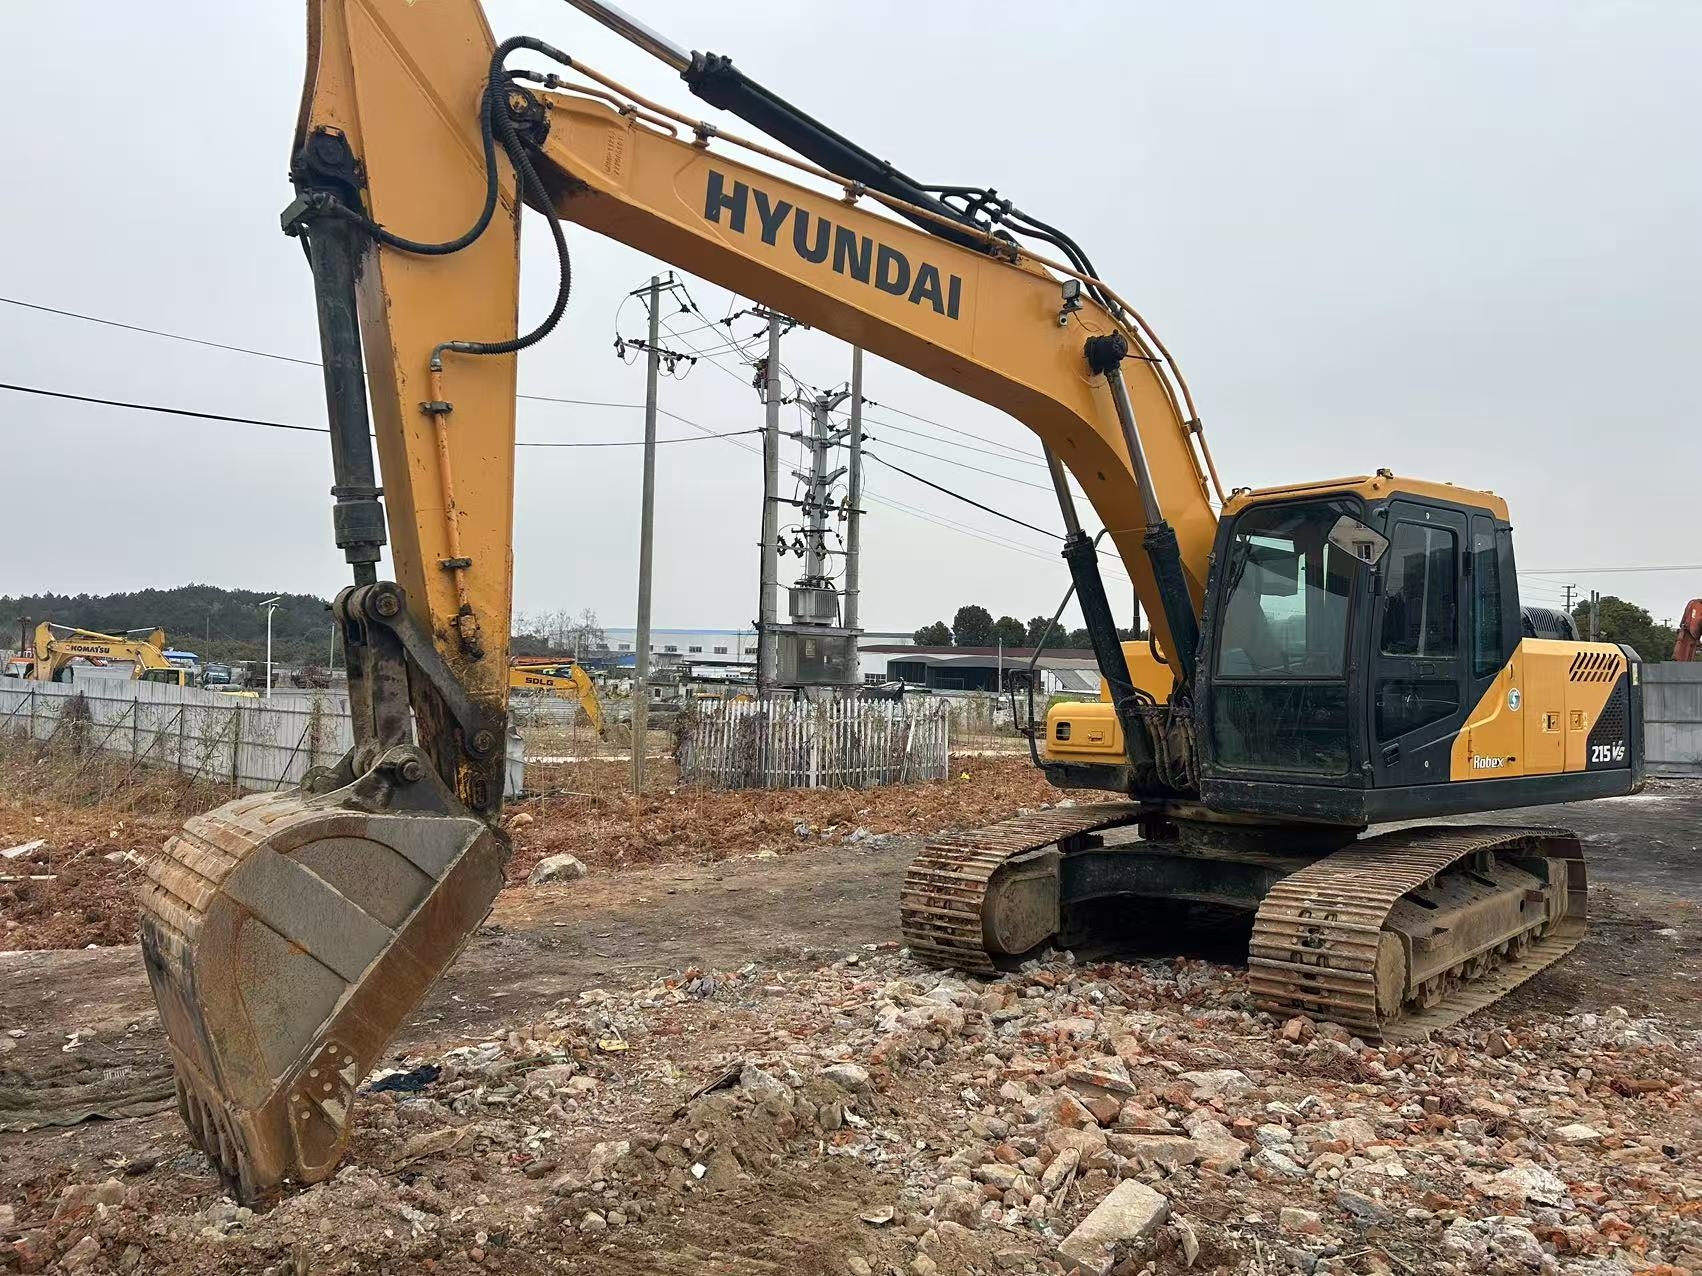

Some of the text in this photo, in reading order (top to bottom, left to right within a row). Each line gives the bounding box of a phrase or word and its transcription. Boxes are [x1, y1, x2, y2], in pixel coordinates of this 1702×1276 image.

[704, 169, 962, 321] HYUNDAI
[71, 645, 110, 653] KOMATSU
[525, 677, 554, 686] SDLG
[1473, 754, 1504, 769] Robex
